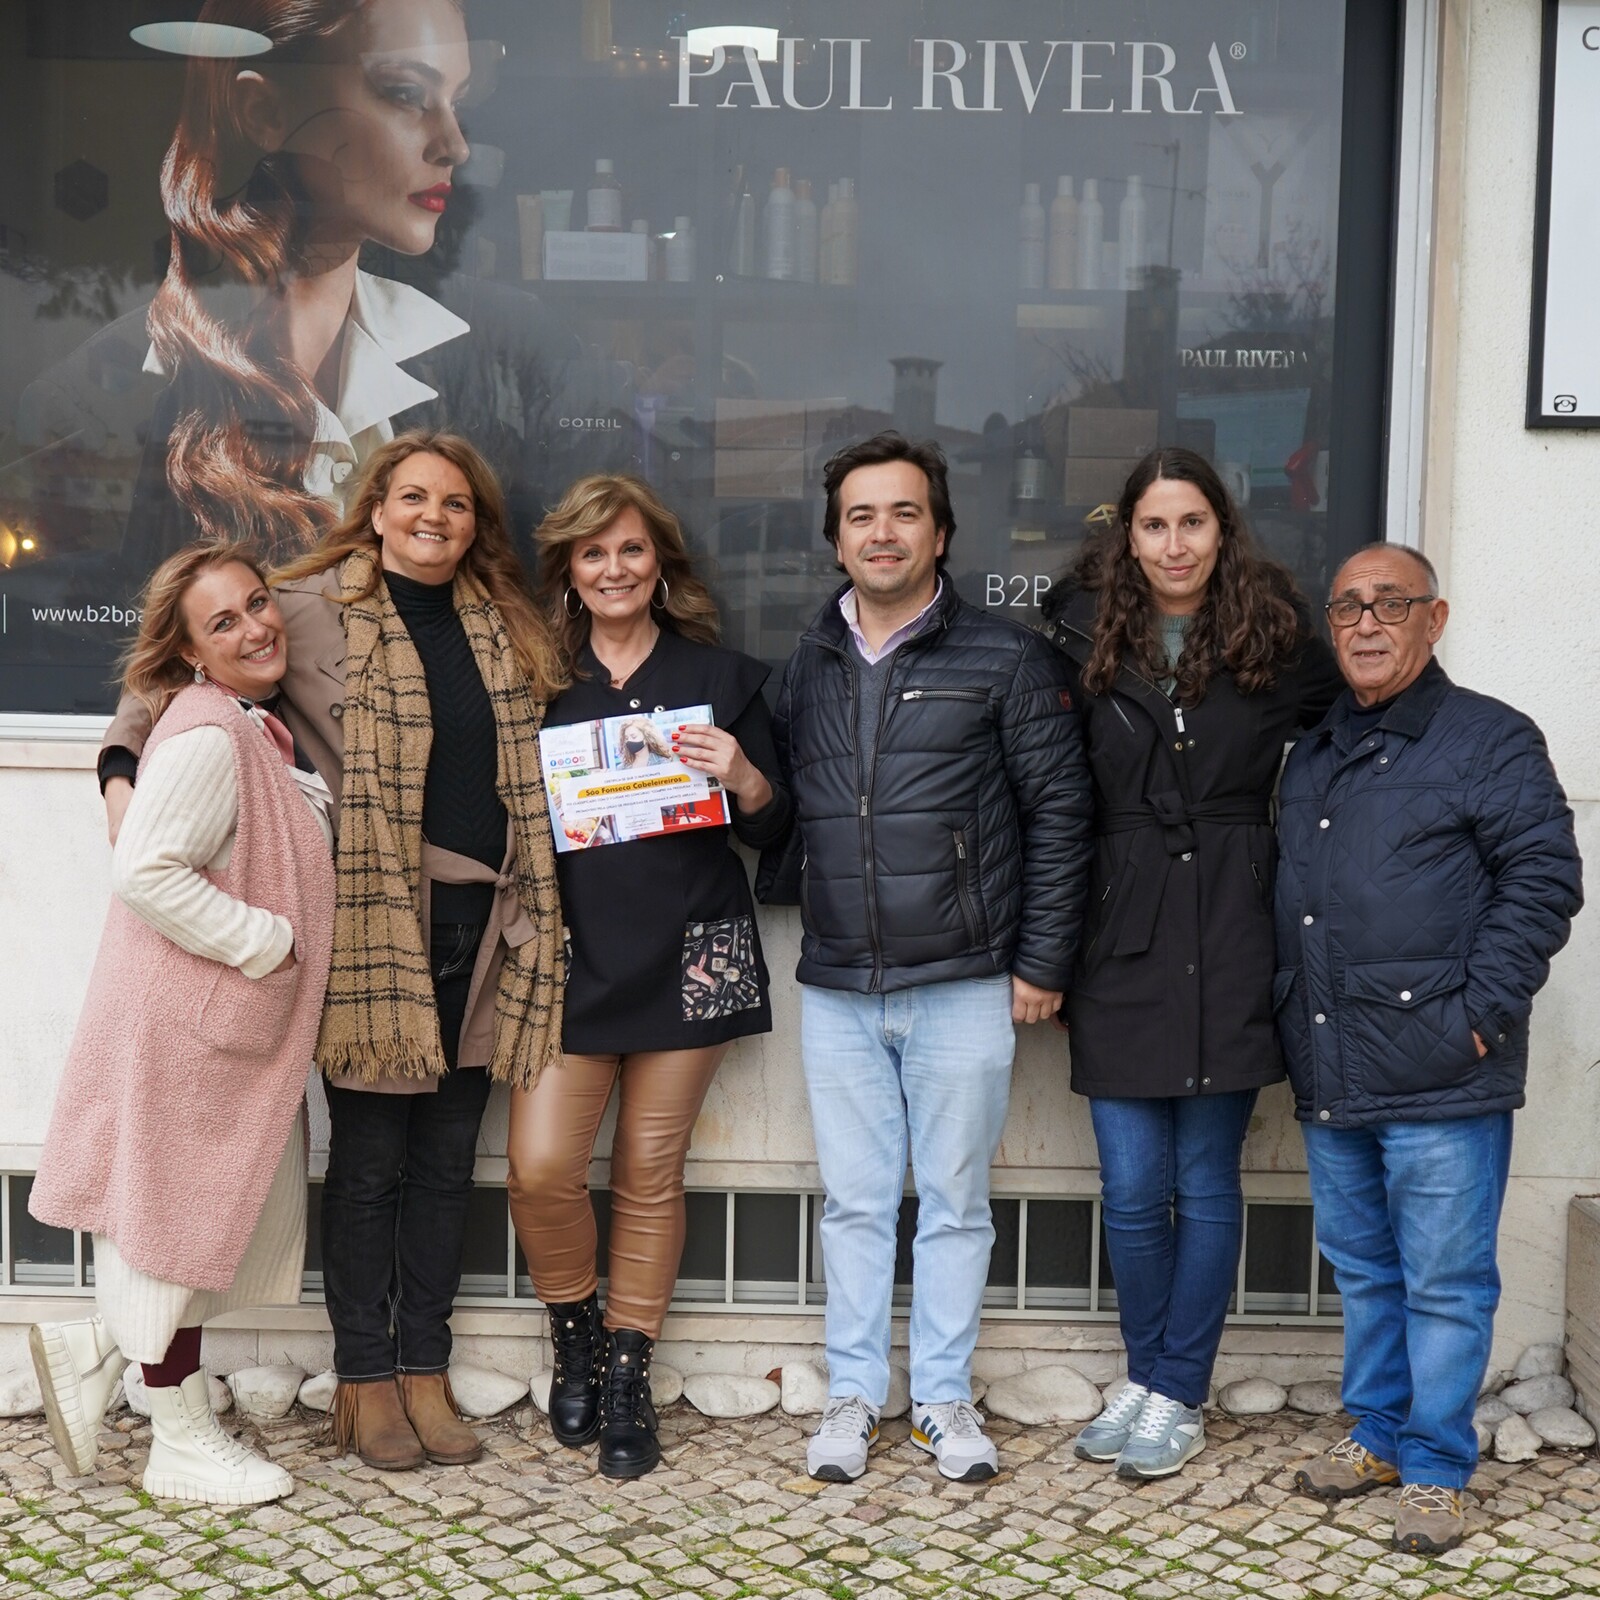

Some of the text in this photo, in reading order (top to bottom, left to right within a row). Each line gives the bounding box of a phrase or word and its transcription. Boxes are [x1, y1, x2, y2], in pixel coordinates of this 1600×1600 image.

[669, 37, 893, 112] PAUL
[1181, 348, 1308, 369] PAUL RIVE
[559, 417, 622, 428] COTRIL
[601, 785, 631, 794] Fonseca
[633, 777, 682, 789] Cabeleireiros
